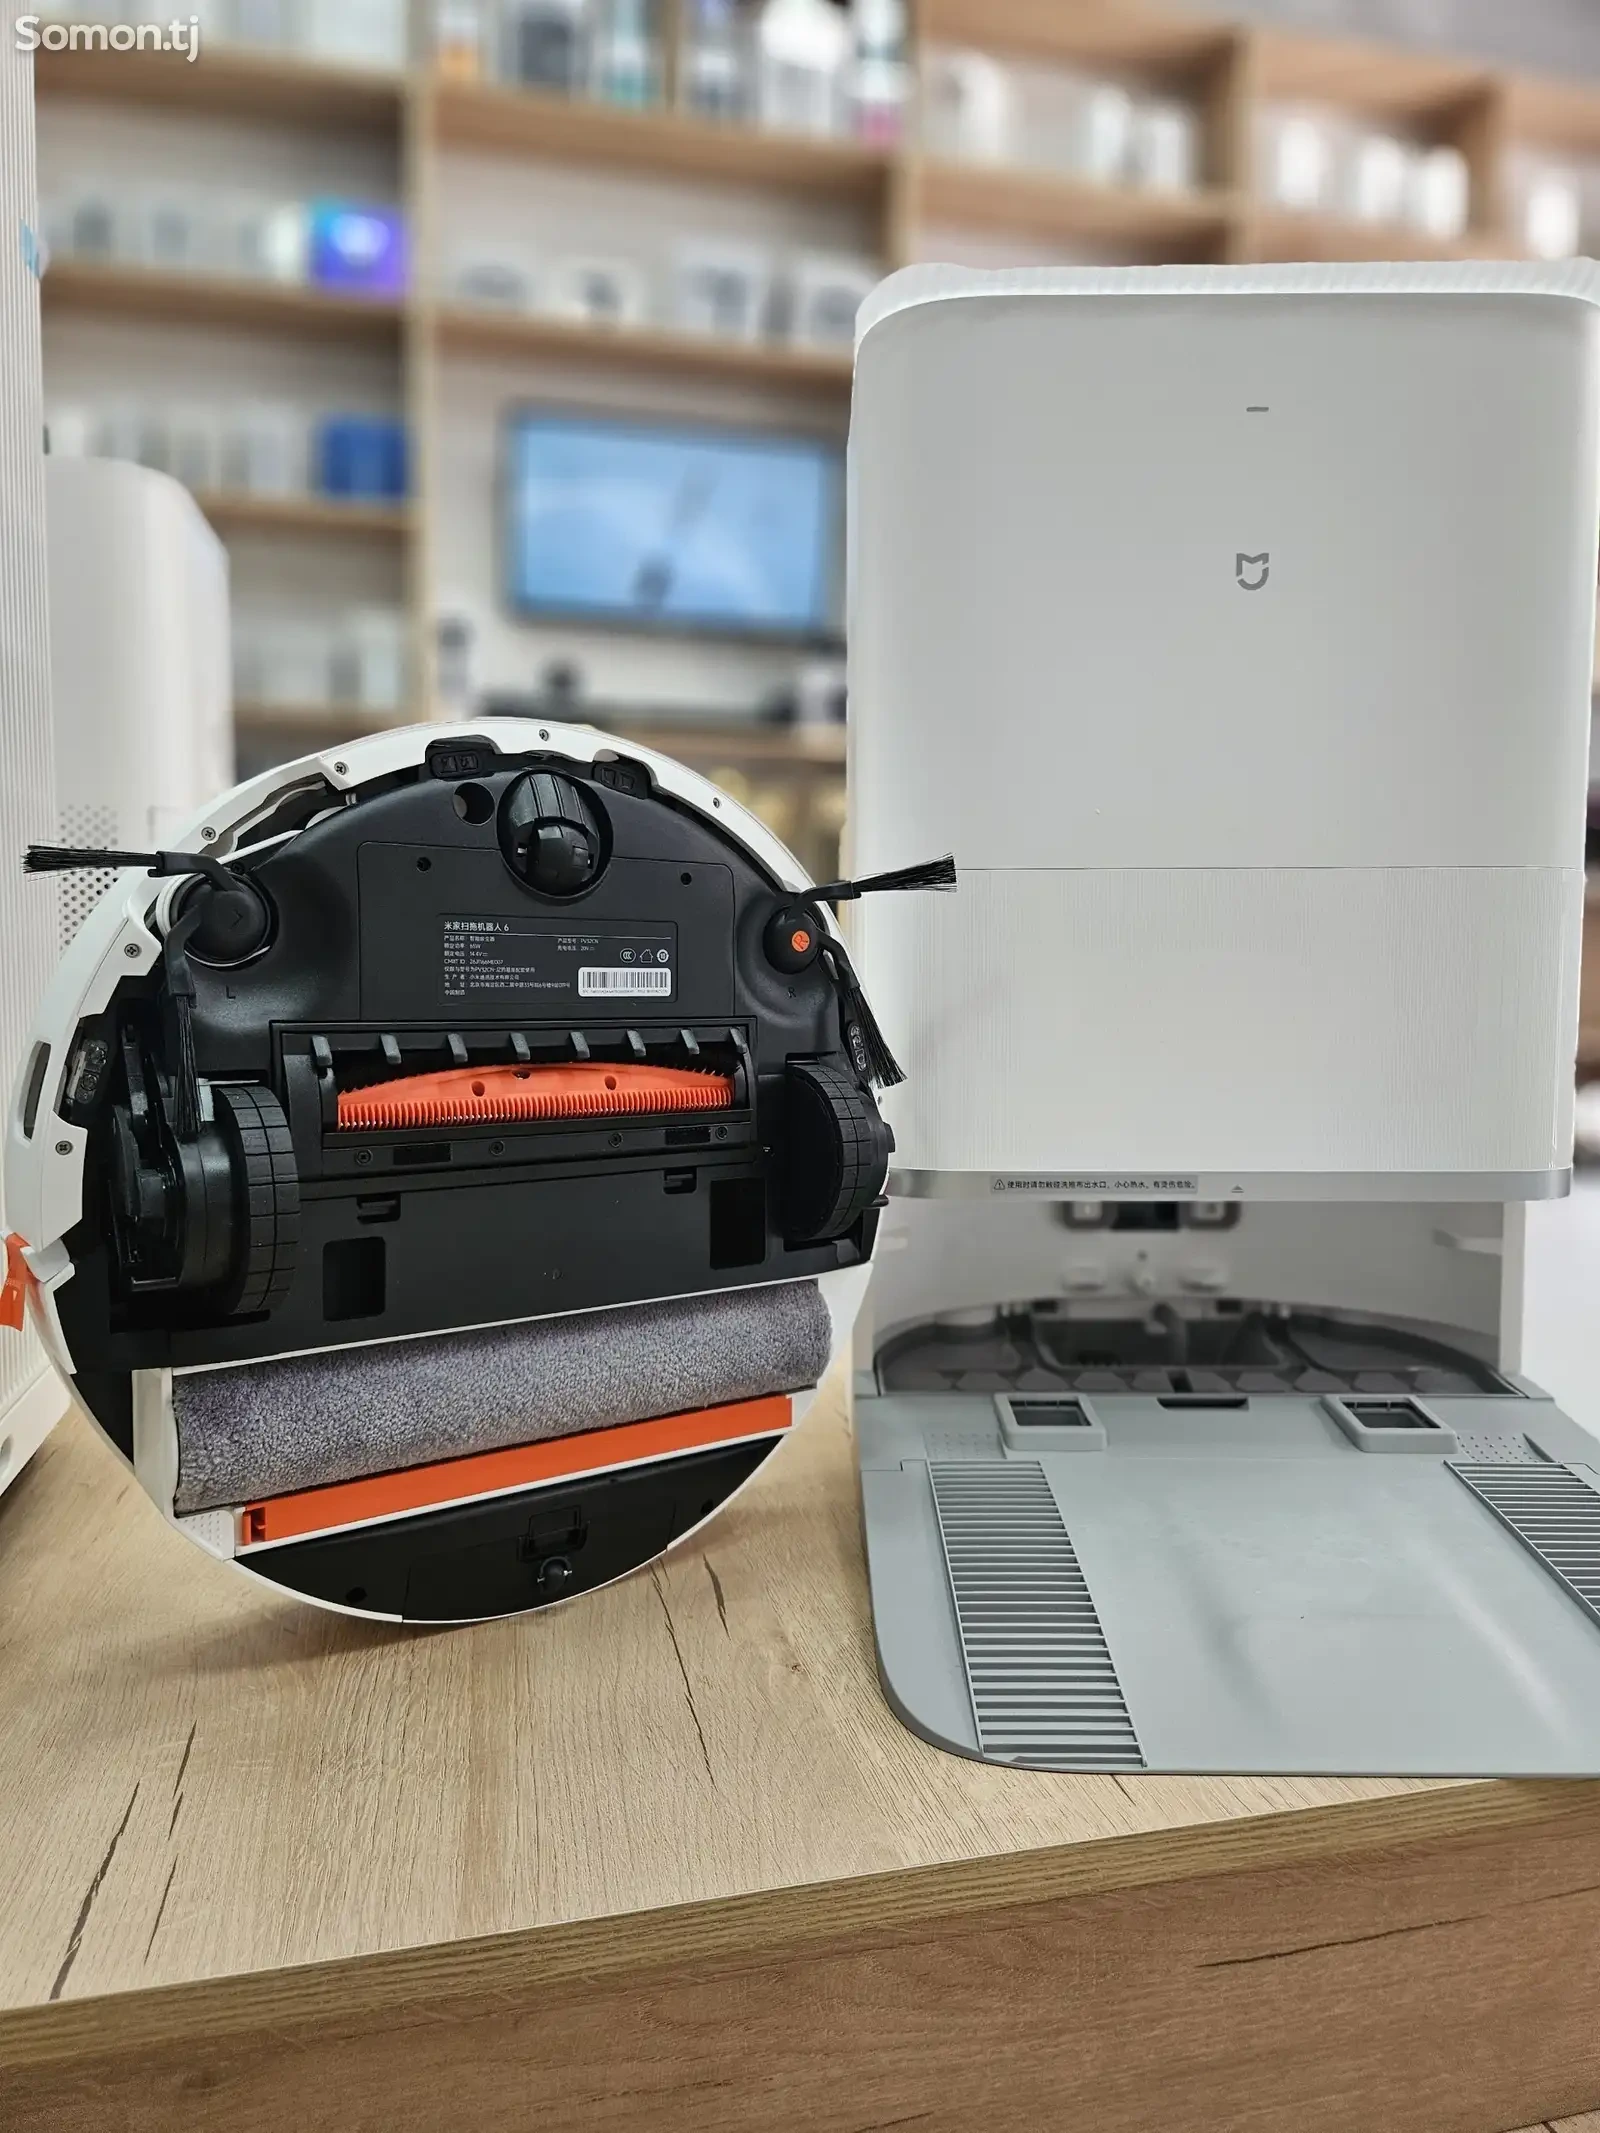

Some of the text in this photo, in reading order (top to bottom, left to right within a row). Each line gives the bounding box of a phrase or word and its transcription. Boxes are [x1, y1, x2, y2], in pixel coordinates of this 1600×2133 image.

[444, 921, 510, 932] 米家扫拖机器人 6
